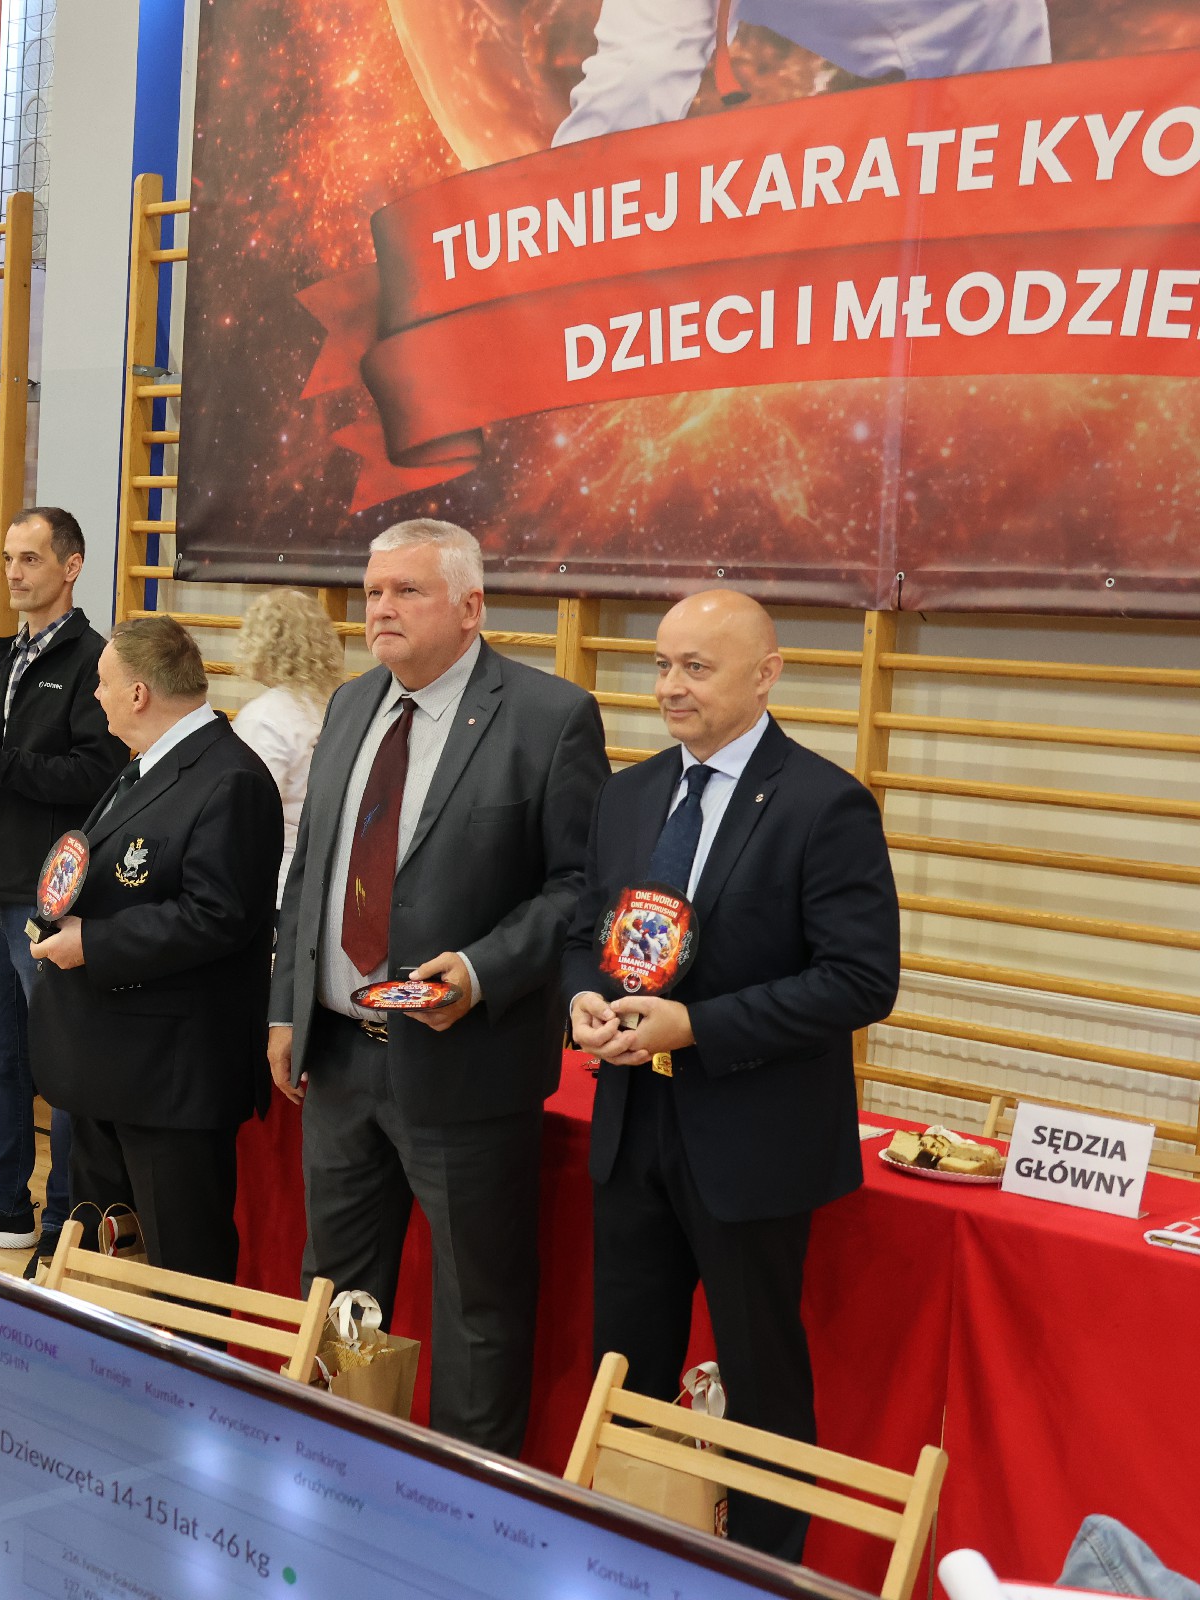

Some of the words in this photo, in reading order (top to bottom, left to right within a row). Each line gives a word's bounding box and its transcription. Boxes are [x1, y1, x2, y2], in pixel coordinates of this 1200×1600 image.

[432, 172, 679, 280] TURNIEJ
[699, 124, 999, 223] KARATE
[564, 289, 774, 383] DZIECI
[796, 282, 812, 346] I
[832, 268, 1200, 342] MŁODZIE
[630, 901, 644, 909] ONE
[635, 891, 652, 901] ONE
[652, 893, 680, 910] WORLD
[1031, 1125, 1127, 1162] SĘDZIA
[1015, 1157, 1135, 1198] GŁÓWNY
[34, 1337, 59, 1360] ONE
[88, 1358, 132, 1389] Turnieje
[144, 1381, 185, 1408] Kumite
[208, 1406, 270, 1444] Zwycięzcy
[295, 1440, 348, 1477] Ranking
[0, 1429, 105, 1497] Dziewczęta
[111, 1480, 168, 1525] 14-15
[173, 1507, 199, 1541] lat
[205, 1527, 240, 1559] -46
[245, 1539, 271, 1579] kg
[395, 1480, 463, 1520] Kategorie
[493, 1519, 536, 1549] Walki
[586, 1557, 651, 1596] Kontakt
